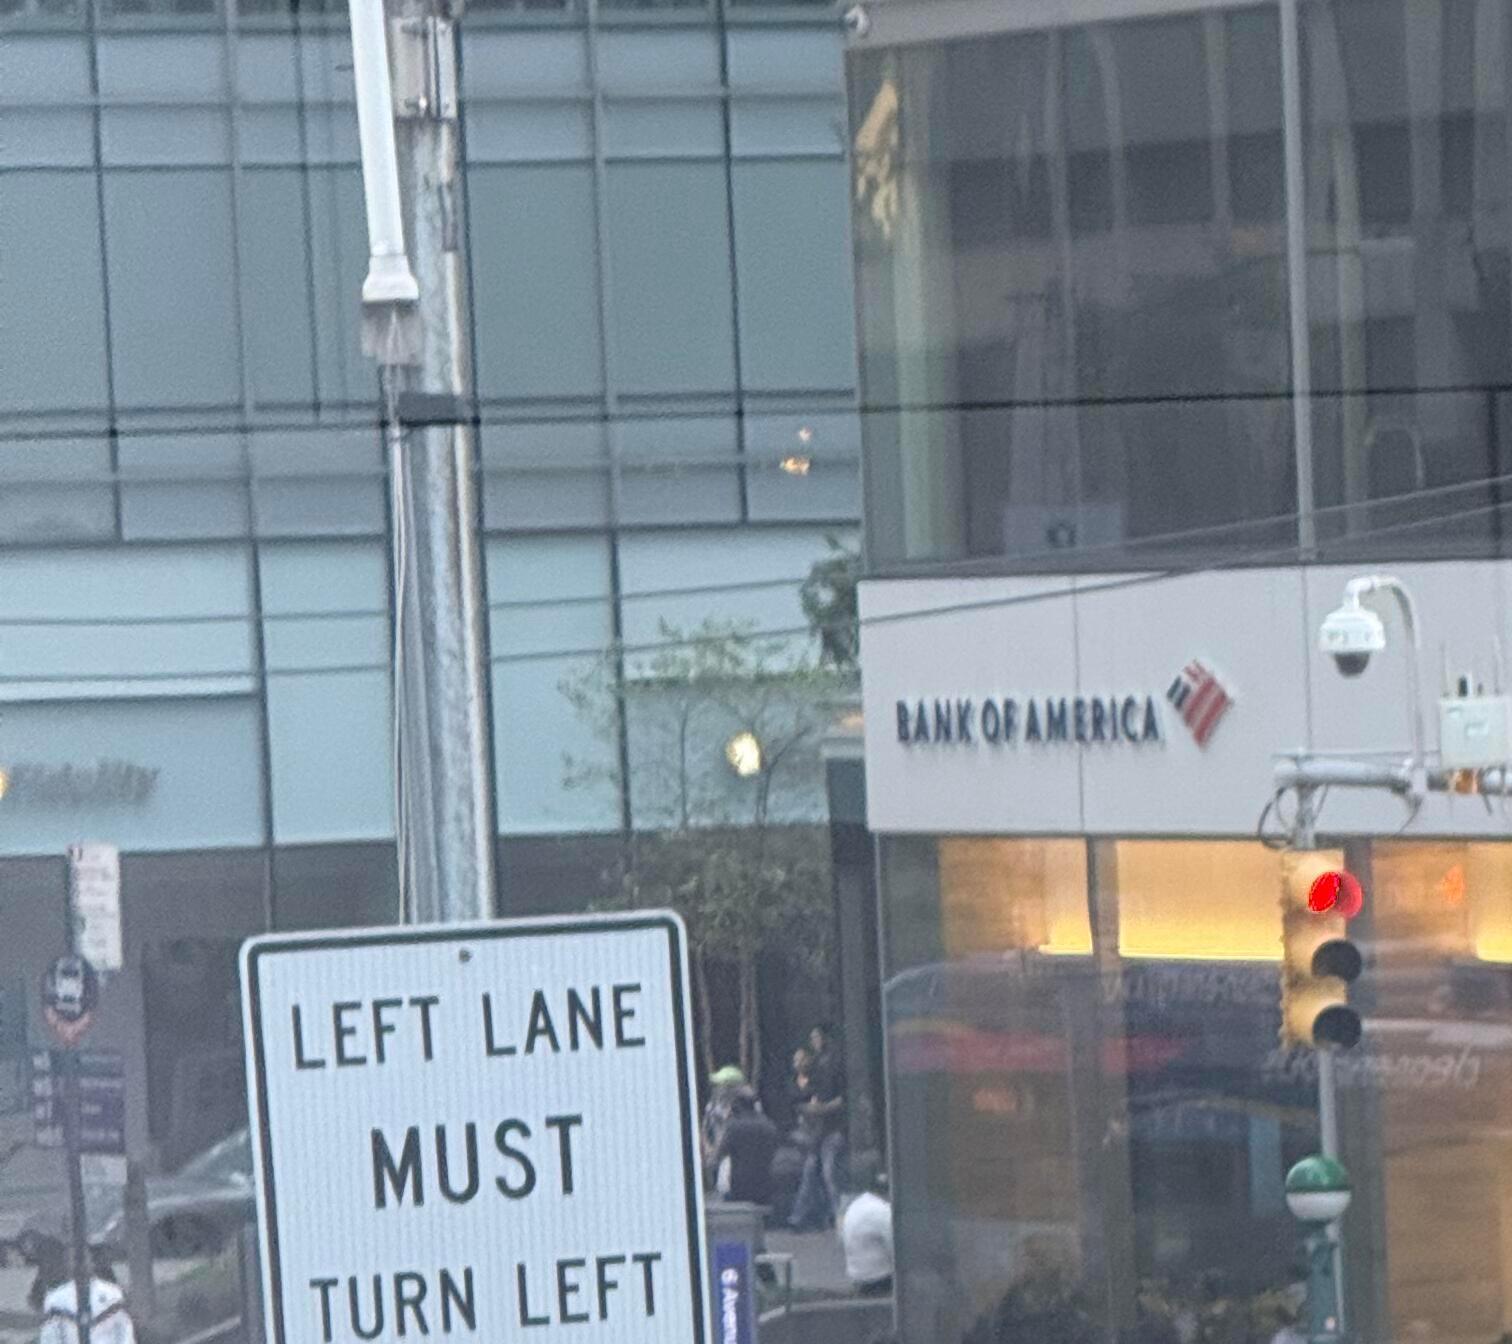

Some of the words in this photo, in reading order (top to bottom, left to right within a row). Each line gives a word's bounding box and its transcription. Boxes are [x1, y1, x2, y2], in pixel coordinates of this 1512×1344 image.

[896, 697, 972, 744] BANK
[981, 696, 1016, 744] OF
[1025, 694, 1160, 744] AMERICA
[291, 994, 440, 1071] LEFT
[481, 982, 647, 1058] LANE
[370, 1112, 584, 1212] MUST
[309, 1266, 477, 1344] TURN
[515, 1251, 662, 1328] LEFT
